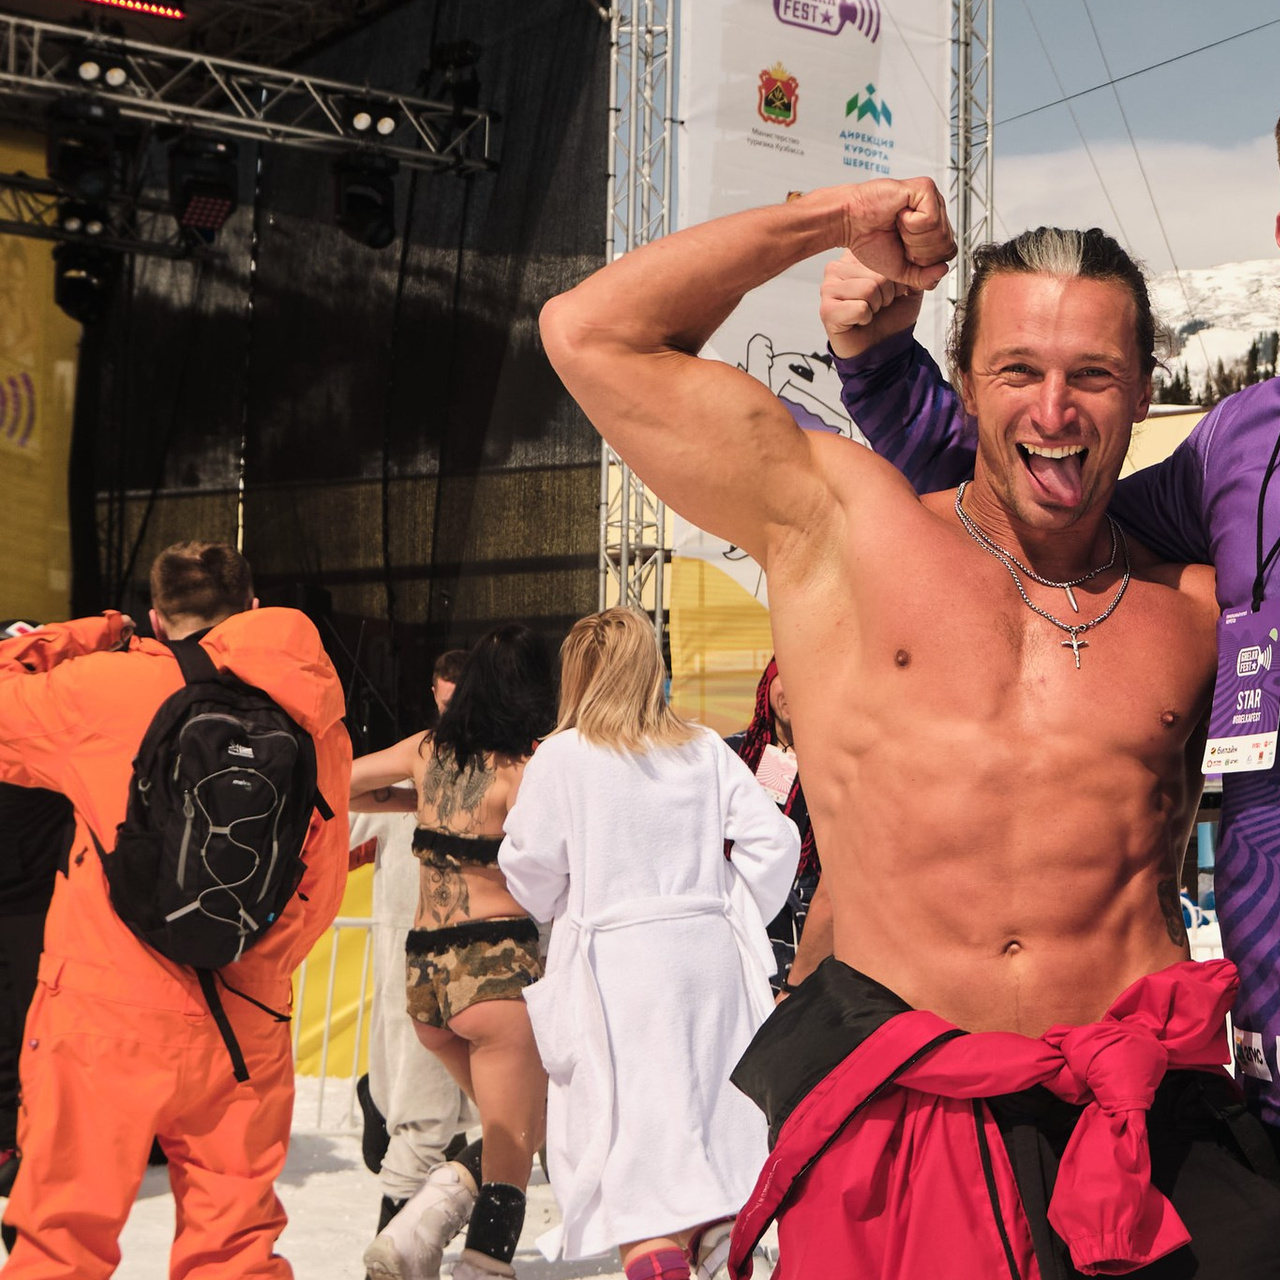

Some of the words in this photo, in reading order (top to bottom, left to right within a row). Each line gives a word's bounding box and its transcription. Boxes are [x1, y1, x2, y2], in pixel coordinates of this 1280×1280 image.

[839, 129, 896, 150] ДИРЕКЦИЯ
[844, 144, 890, 162] КУРОРТА
[842, 156, 892, 176] ШЕРЕГЕШ
[1236, 688, 1262, 711] STAR
